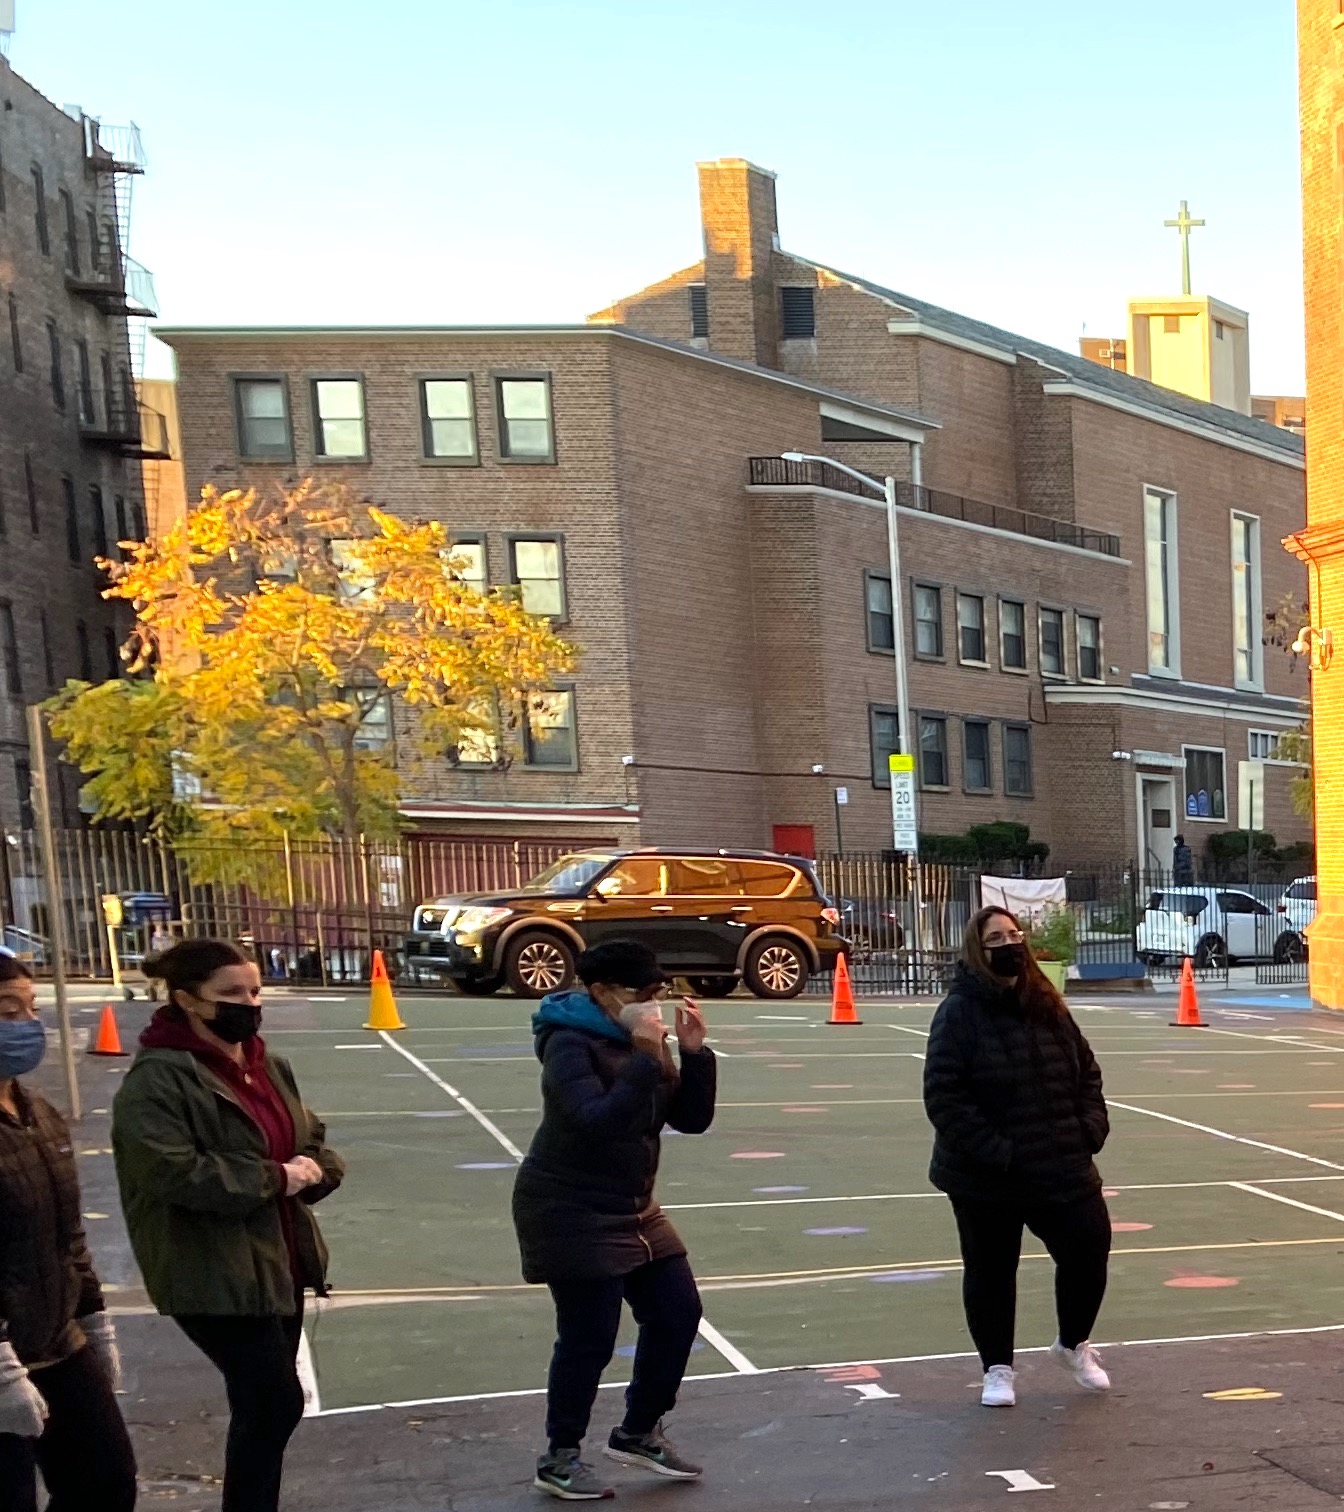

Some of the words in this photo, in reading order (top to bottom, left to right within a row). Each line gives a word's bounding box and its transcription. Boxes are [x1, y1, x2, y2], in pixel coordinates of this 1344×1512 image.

[896, 791, 910, 805] 20
[843, 1383, 901, 1400] 1
[985, 1469, 1055, 1492] 1
